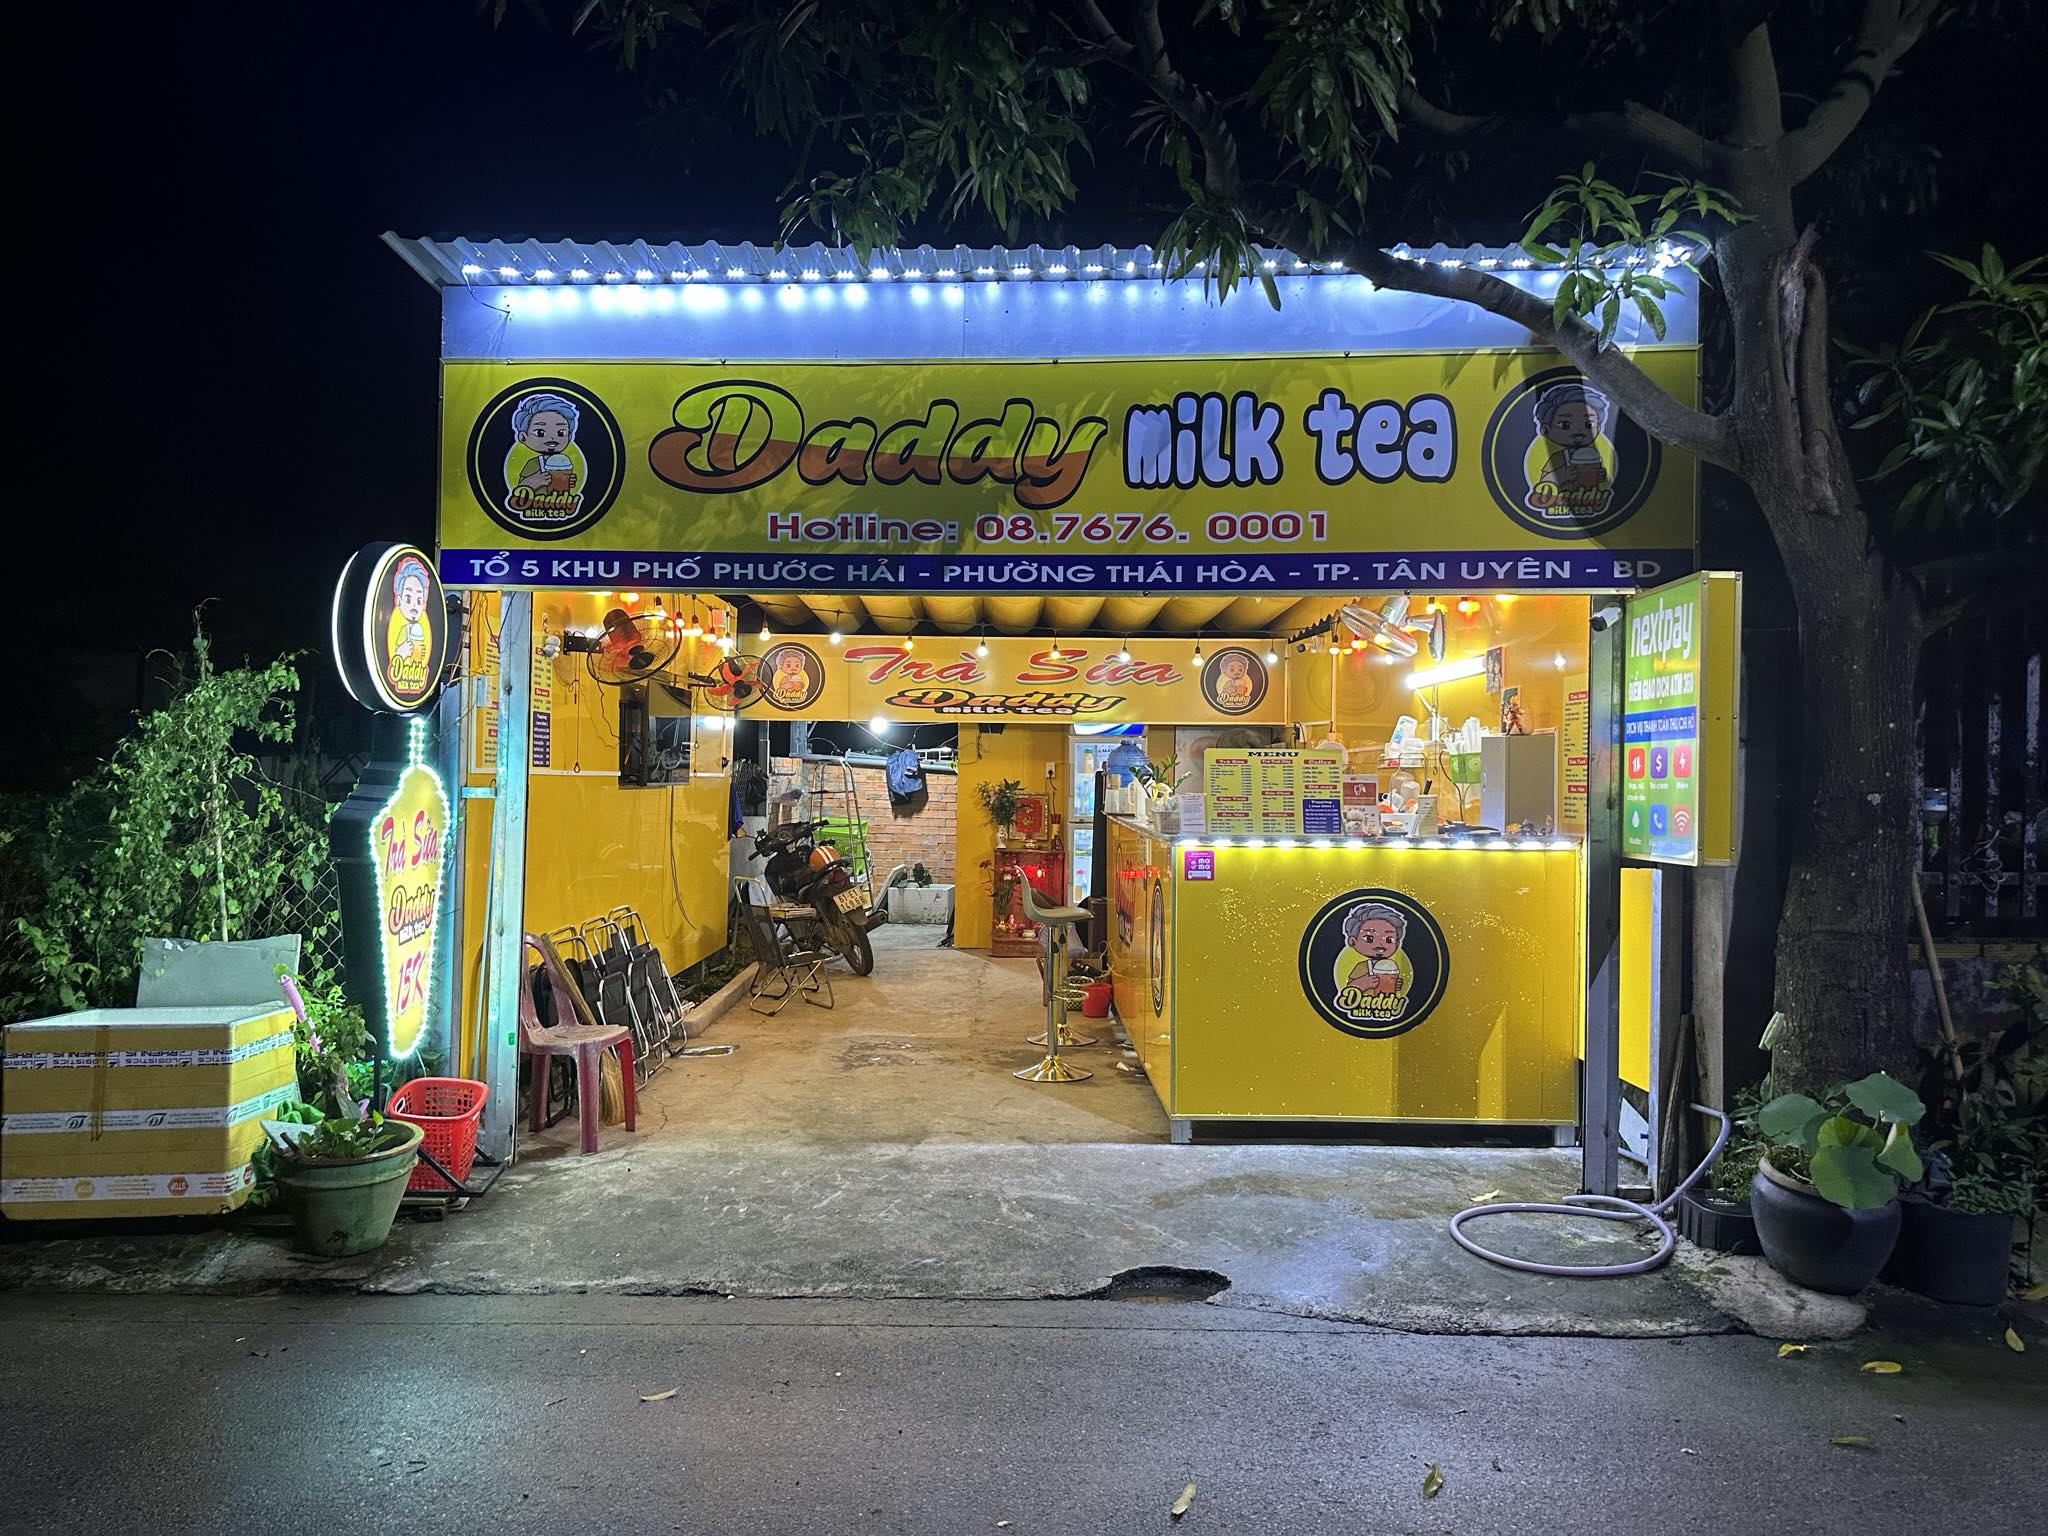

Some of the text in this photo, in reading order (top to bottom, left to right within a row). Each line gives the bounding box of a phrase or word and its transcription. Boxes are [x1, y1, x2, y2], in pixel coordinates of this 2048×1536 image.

[648, 379, 1458, 510] Daddy milk tea
[510, 485, 580, 514] Daddy
[1530, 481, 1610, 511] Daddy
[1574, 506, 1593, 514] tea
[525, 508, 566, 517] milk tea
[768, 511, 1328, 543] Hotline: 08.7676. 0001
[470, 551, 510, 577] TỔ
[521, 559, 540, 578] 5
[552, 559, 620, 579] KHU
[633, 556, 702, 580] PHỐ
[714, 559, 835, 582] PHƯỚC
[847, 558, 905, 582] HẢI
[944, 561, 1096, 583] PHƯỜNG
[1106, 561, 1183, 583] THÁI
[1196, 561, 1276, 583] HÒA
[1313, 563, 1359, 581] TP.
[1372, 559, 1445, 581] TÂN
[1460, 557, 1570, 581] UYÊN
[1613, 560, 1662, 578] BD
[1631, 597, 1693, 663] nextpay
[391, 655, 428, 688] Daddy
[844, 647, 1184, 686] Trà Sữa
[885, 688, 1127, 713] Daddy
[942, 706, 1075, 715] milk tea
[1219, 692, 1249, 705] Daddy
[381, 810, 438, 881] Trà Sữa
[389, 884, 436, 936] Daddy
[396, 951, 427, 1016] 15K
[1338, 988, 1406, 1016] Daddy
[1352, 1010, 1392, 1018] milk tea
